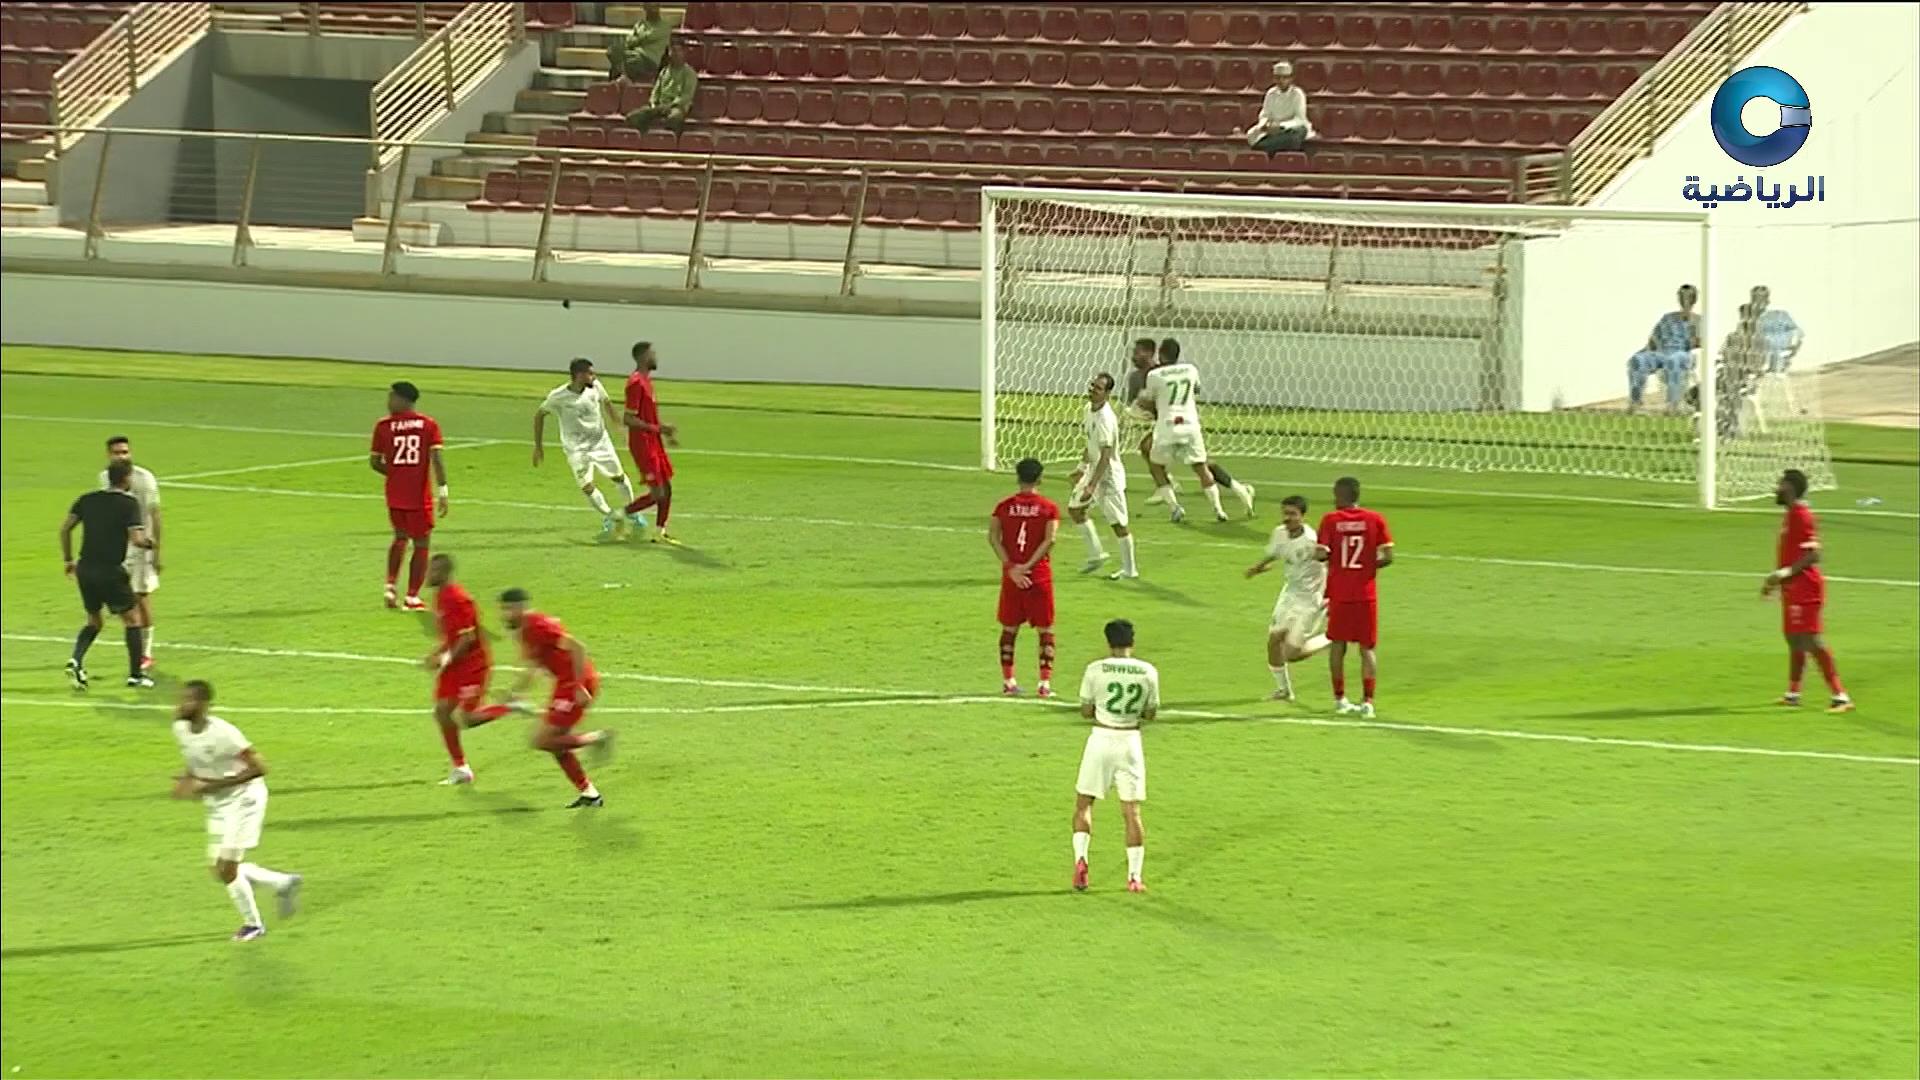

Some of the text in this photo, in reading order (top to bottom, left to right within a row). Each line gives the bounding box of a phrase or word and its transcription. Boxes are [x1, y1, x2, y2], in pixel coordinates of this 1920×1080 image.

[1167, 380, 1191, 405] 77
[393, 435, 420, 464] 28
[1017, 521, 1027, 552] 4
[1341, 535, 1364, 568] 12
[1107, 682, 1143, 714] 22
